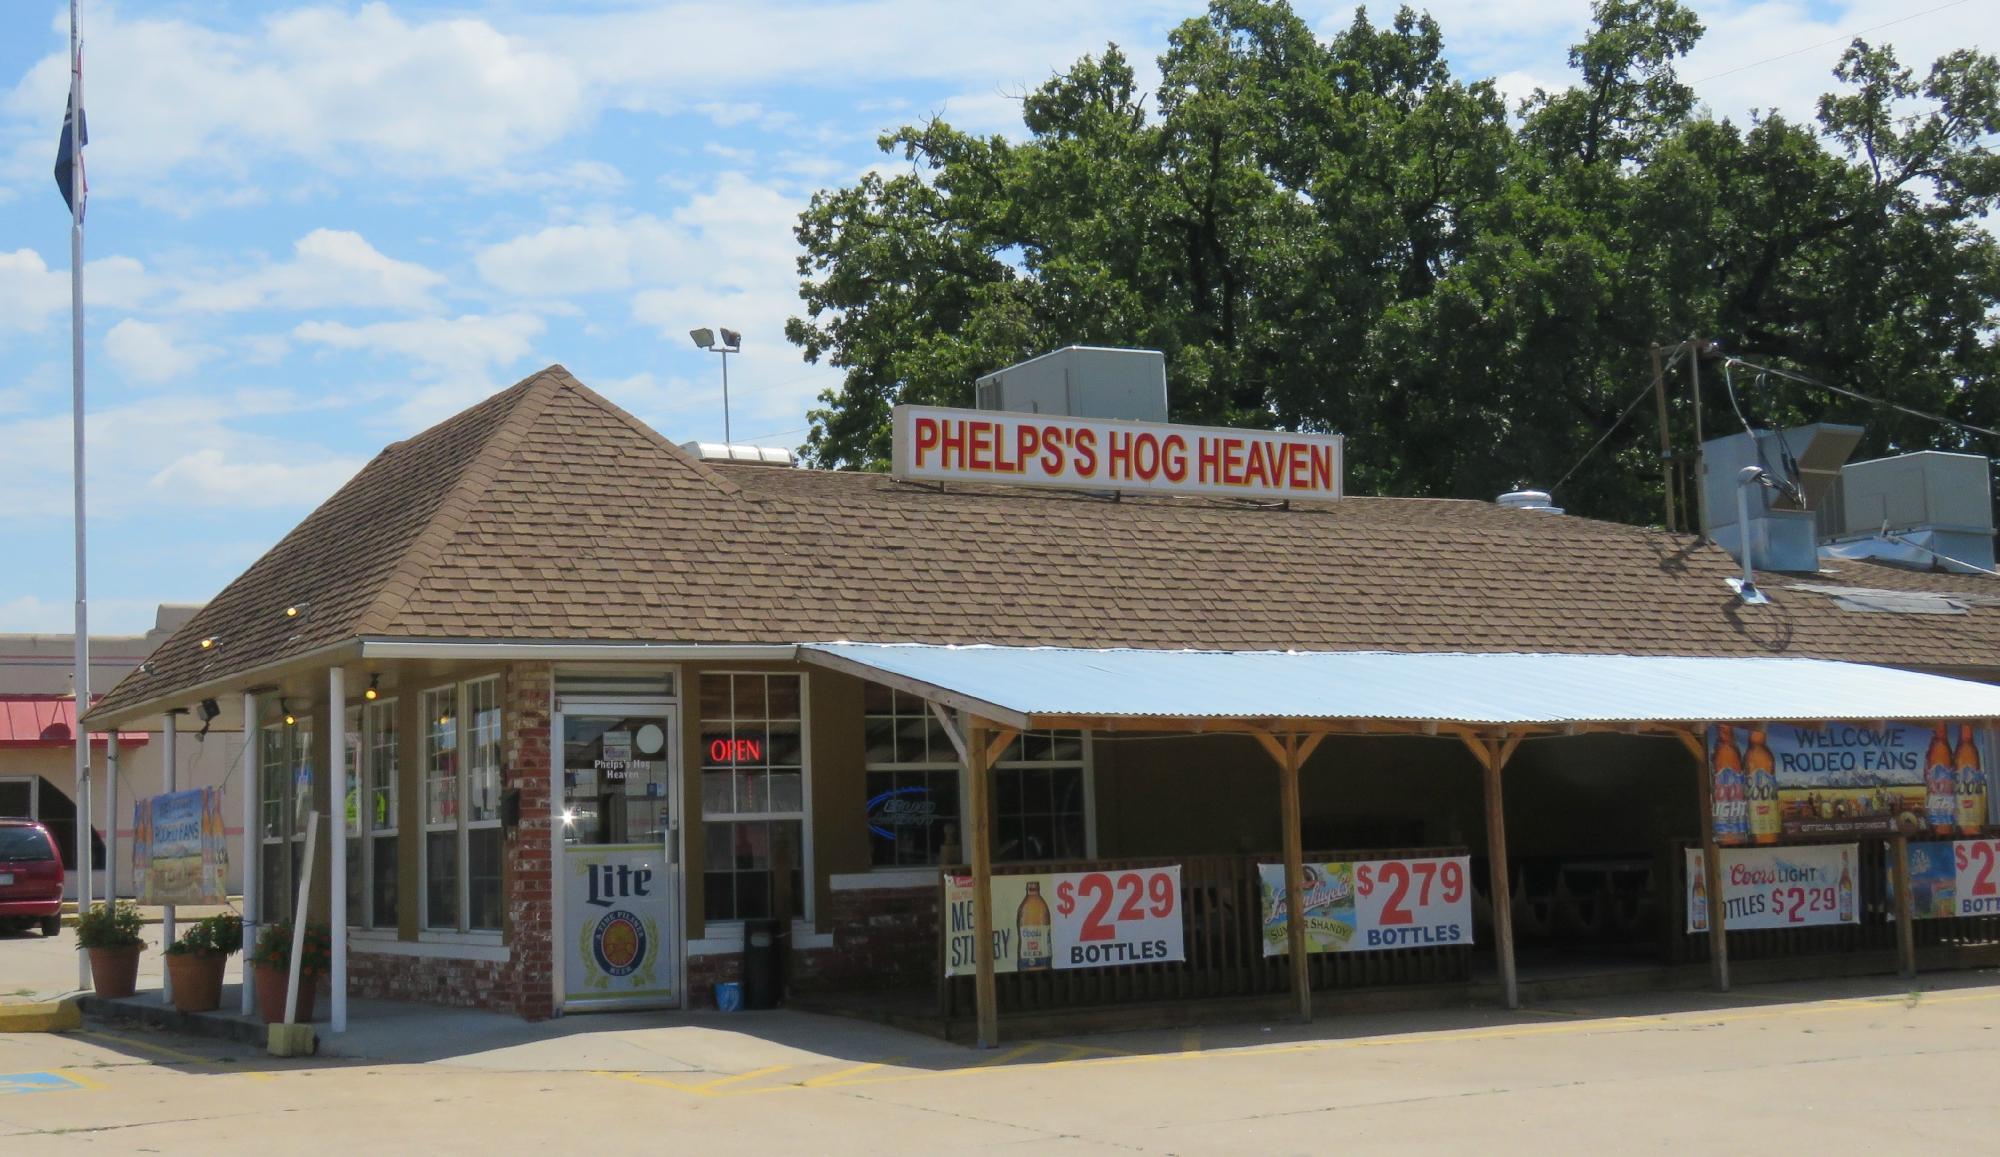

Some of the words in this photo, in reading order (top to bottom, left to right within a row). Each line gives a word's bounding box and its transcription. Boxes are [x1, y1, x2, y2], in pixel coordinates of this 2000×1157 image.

[914, 417, 1097, 477] PHELPS'S
[1108, 430, 1188, 483] HOG
[1199, 436, 1333, 491] HEAVEN
[1793, 728, 1905, 748] WELCOME
[711, 739, 761, 762] OPEN
[1780, 752, 1856, 772] RODEO
[1863, 751, 1918, 771] FANS
[607, 770, 639, 779] Heaven
[585, 864, 652, 907] Lite
[1730, 863, 1776, 886] Coors
[1778, 867, 1817, 883] LIGHT
[1311, 918, 1349, 937] SHANDY
[1367, 924, 1461, 946] BOTTLES
[1070, 940, 1168, 964] BOTTLES
